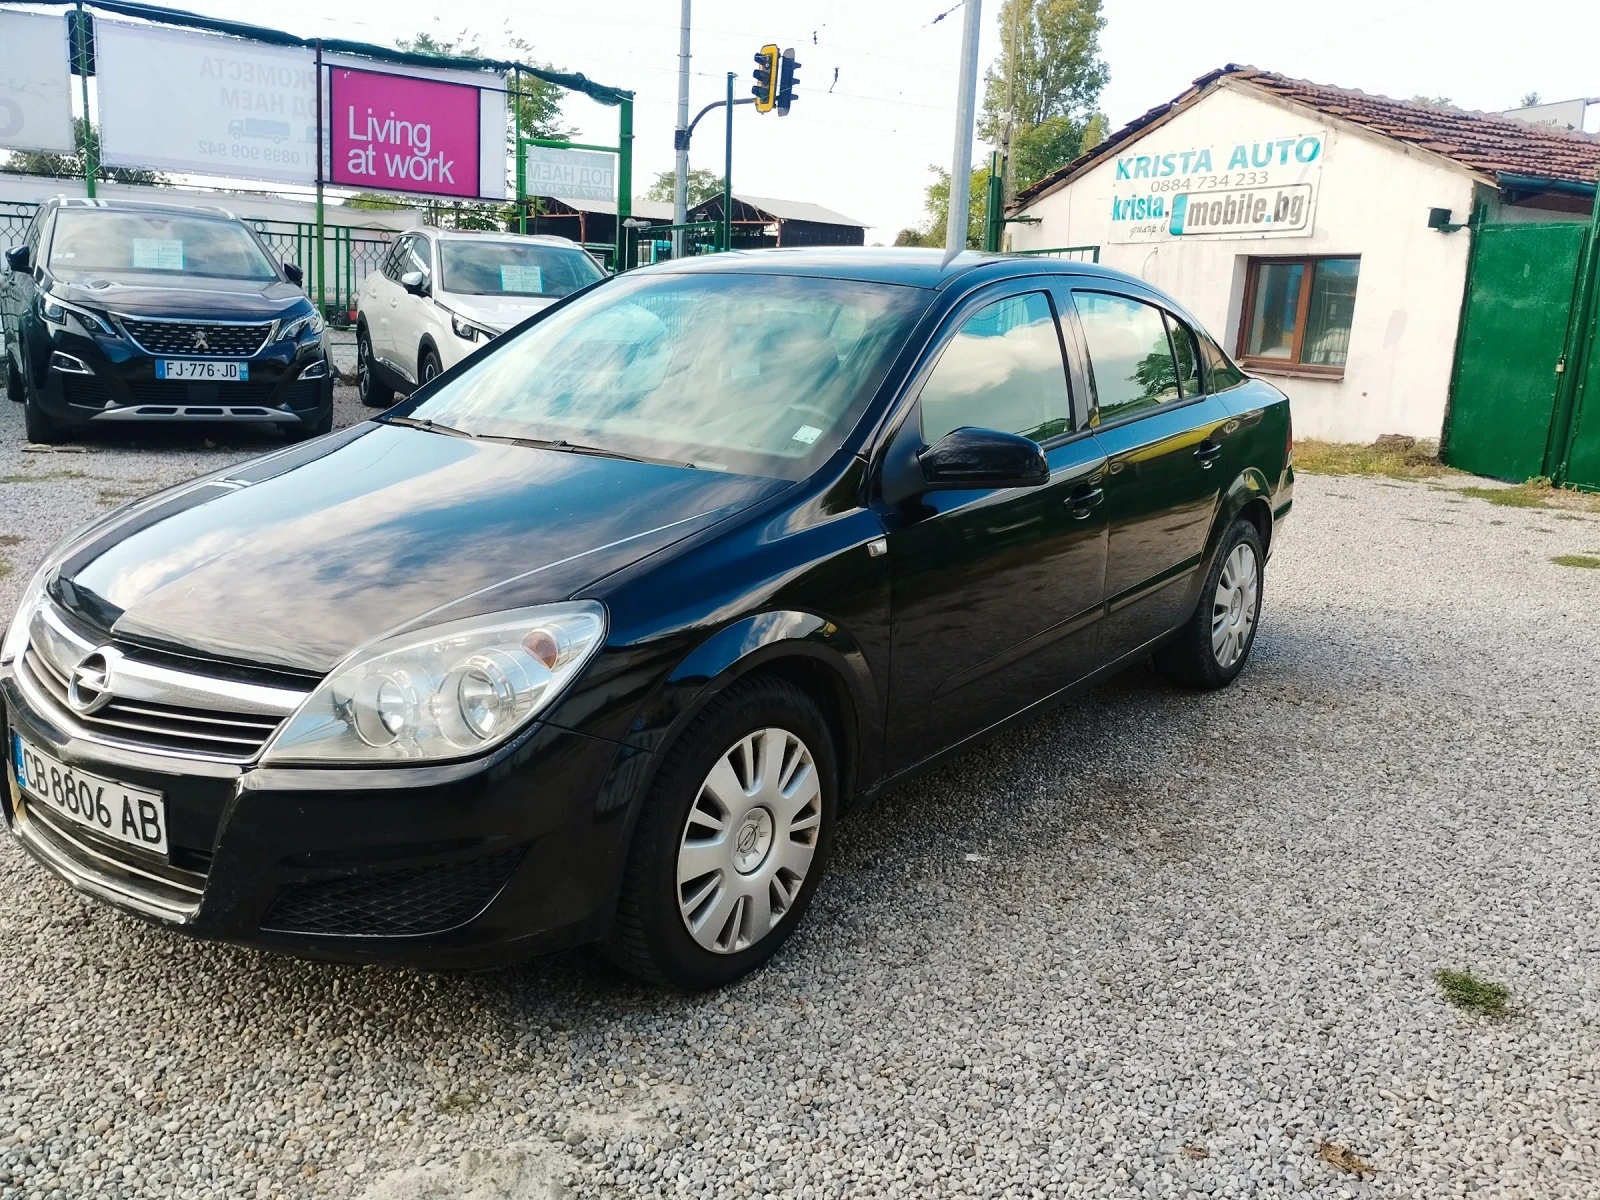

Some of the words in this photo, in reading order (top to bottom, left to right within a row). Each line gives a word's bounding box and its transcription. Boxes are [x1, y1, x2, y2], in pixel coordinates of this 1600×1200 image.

[348, 105, 431, 157] Living
[347, 143, 377, 176] at
[383, 151, 455, 184] work
[1115, 149, 1213, 181] KRISTA
[1227, 136, 1321, 171] AUTO
[1150, 177, 1192, 193] 0884
[1197, 174, 1230, 189] 734
[1235, 171, 1269, 186] 233
[1187, 191, 1305, 226] mobile.bg
[166, 362, 237, 378] FJ-776-JD
[51, 766, 112, 829] 8806
